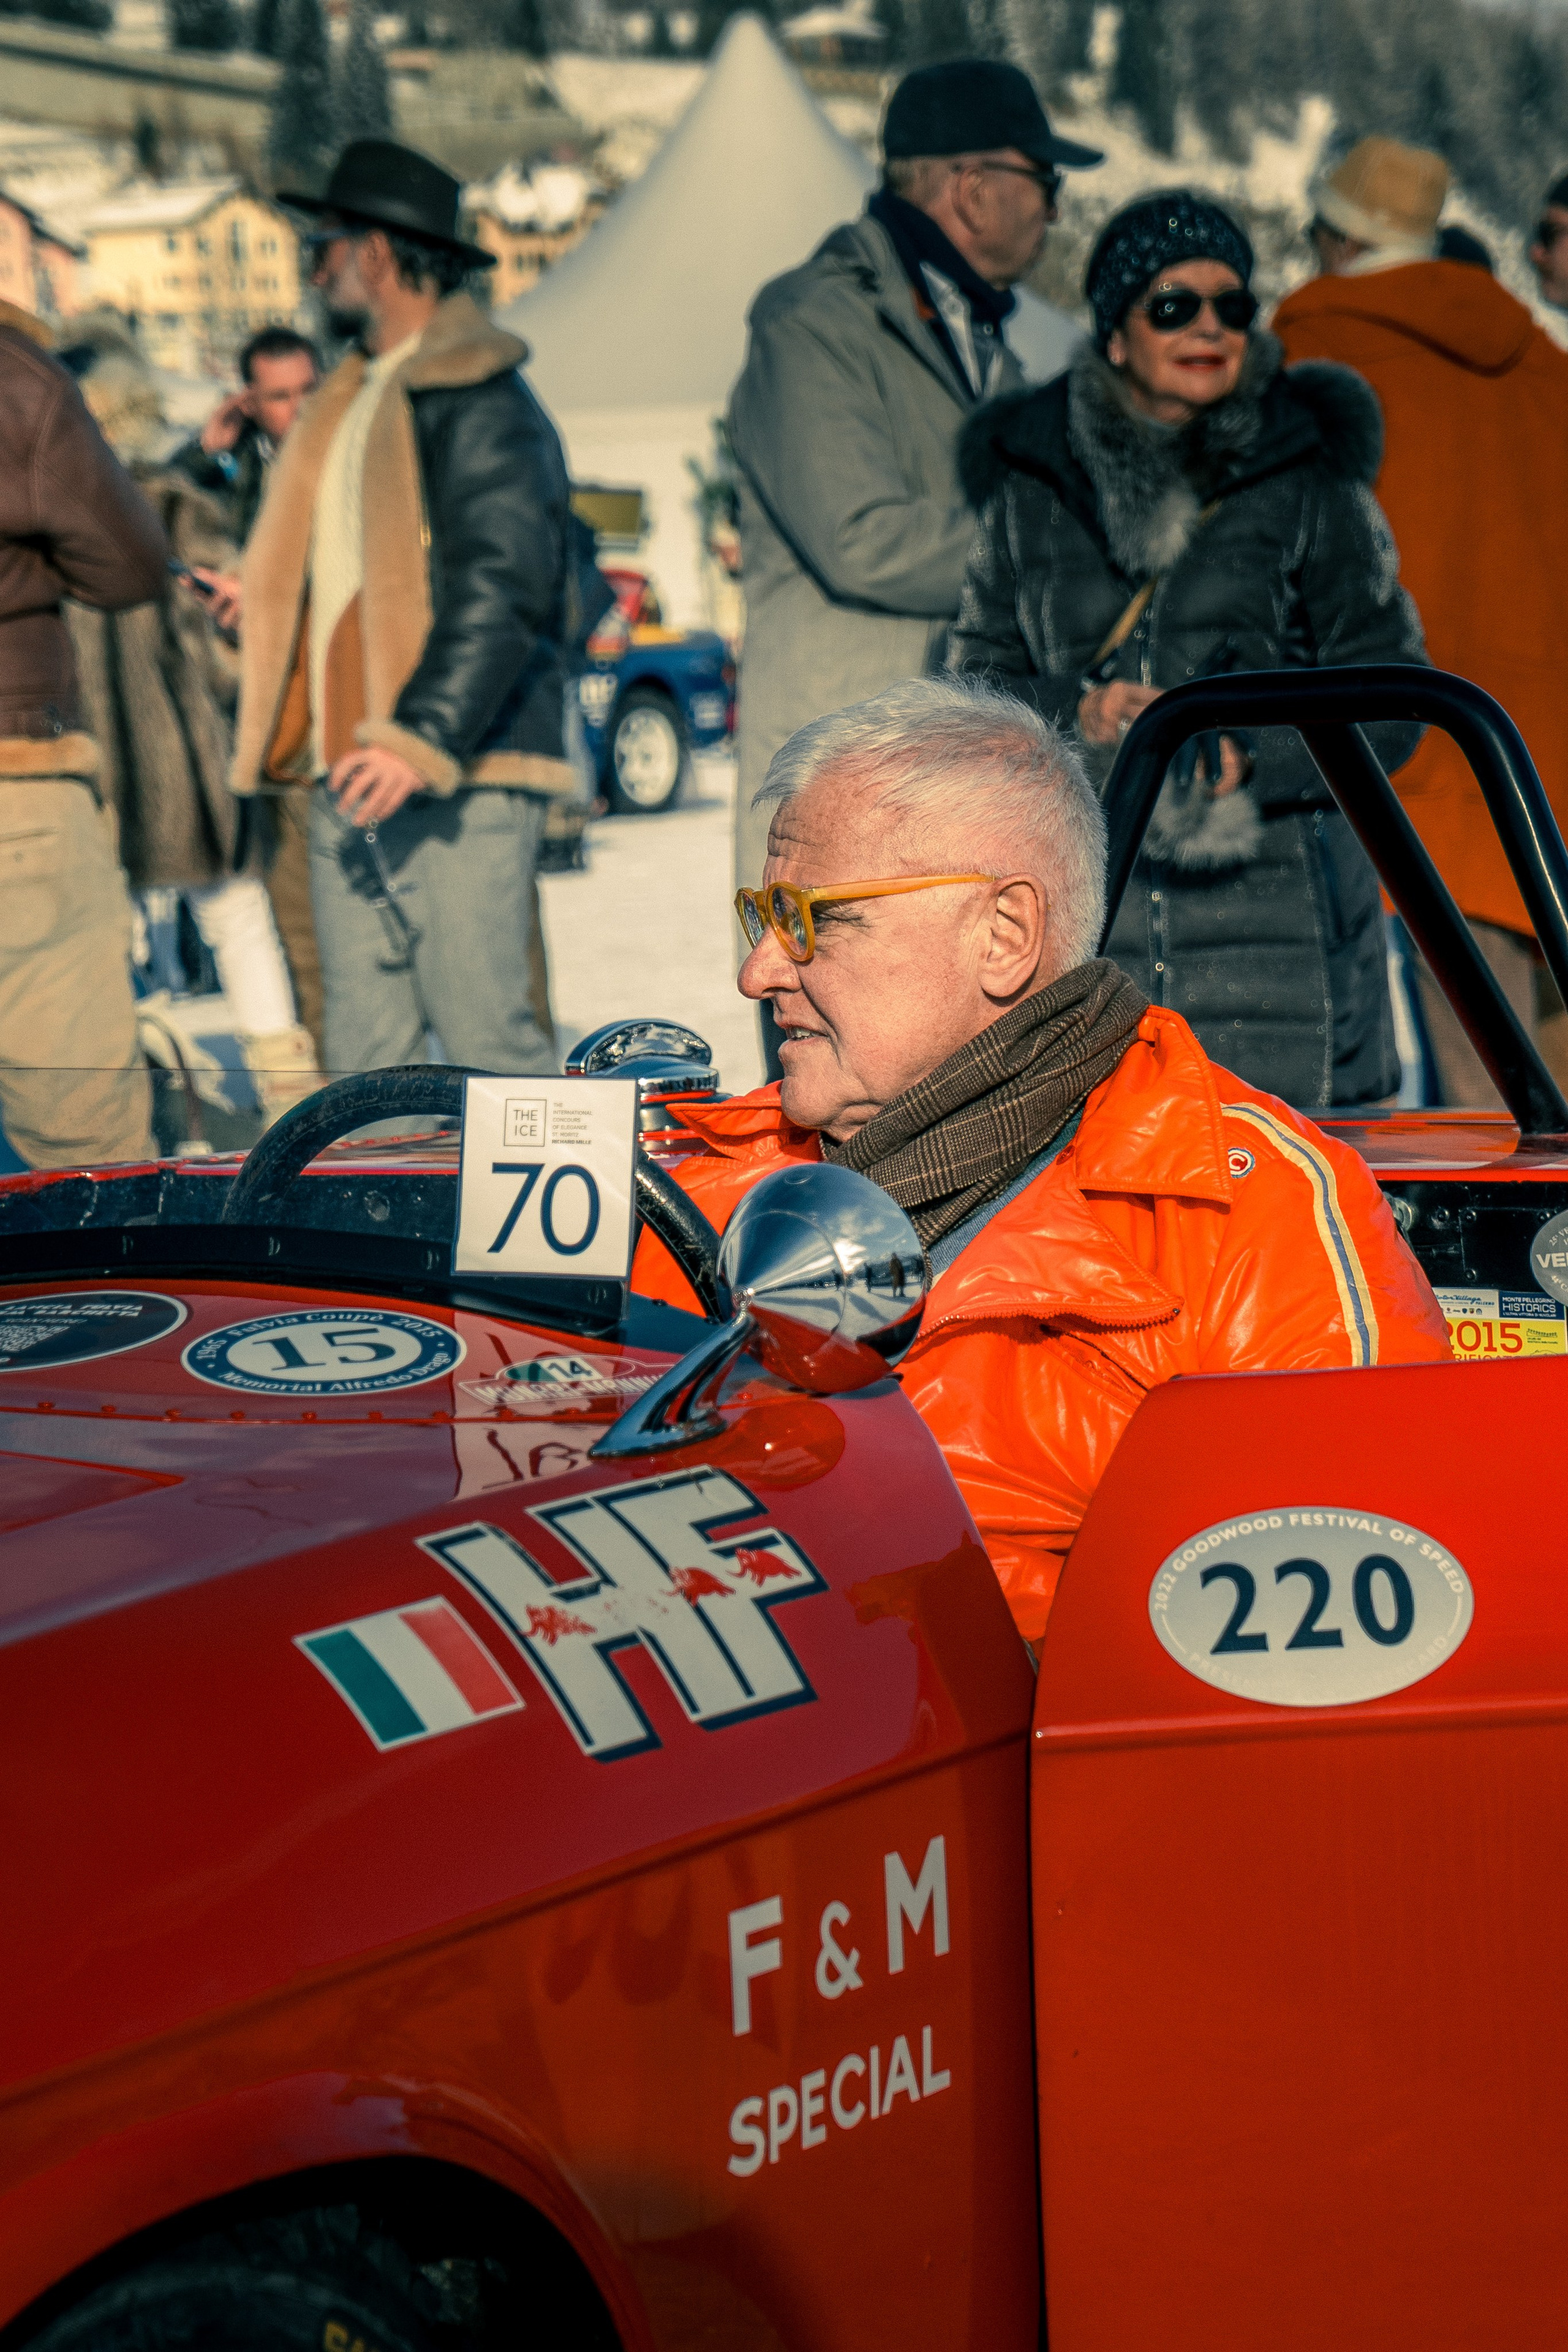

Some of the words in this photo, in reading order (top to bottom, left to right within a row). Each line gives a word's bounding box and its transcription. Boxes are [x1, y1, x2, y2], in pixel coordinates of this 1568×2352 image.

[513, 1109, 538, 1121] THE
[514, 1125, 538, 1137] ICE
[487, 1162, 601, 1256] 70
[1502, 1303, 1556, 1313] HISTORICS
[195, 1340, 228, 1360] 1965
[226, 1317, 299, 1337] Fulvia
[391, 1318, 445, 1337] 2015
[252, 1328, 396, 1371] 15
[218, 1371, 322, 1392] Memorial
[329, 1374, 413, 1391] Alfredo
[408, 1352, 452, 1376] Drago
[548, 1360, 592, 1378] 14
[1154, 1572, 1177, 1611] 2022
[1172, 1515, 1283, 1572] GOODWOOD
[1289, 1512, 1382, 1536] FESTIVAL
[1389, 1528, 1417, 1545] OF
[1418, 1543, 1464, 1593] SPEED
[415, 1464, 830, 1763] HF
[1199, 1553, 1415, 1656] 220
[728, 1894, 782, 2037] F
[815, 1900, 863, 2000] &
[884, 1834, 951, 1975] M
[727, 2024, 951, 2177] SPECIAL
